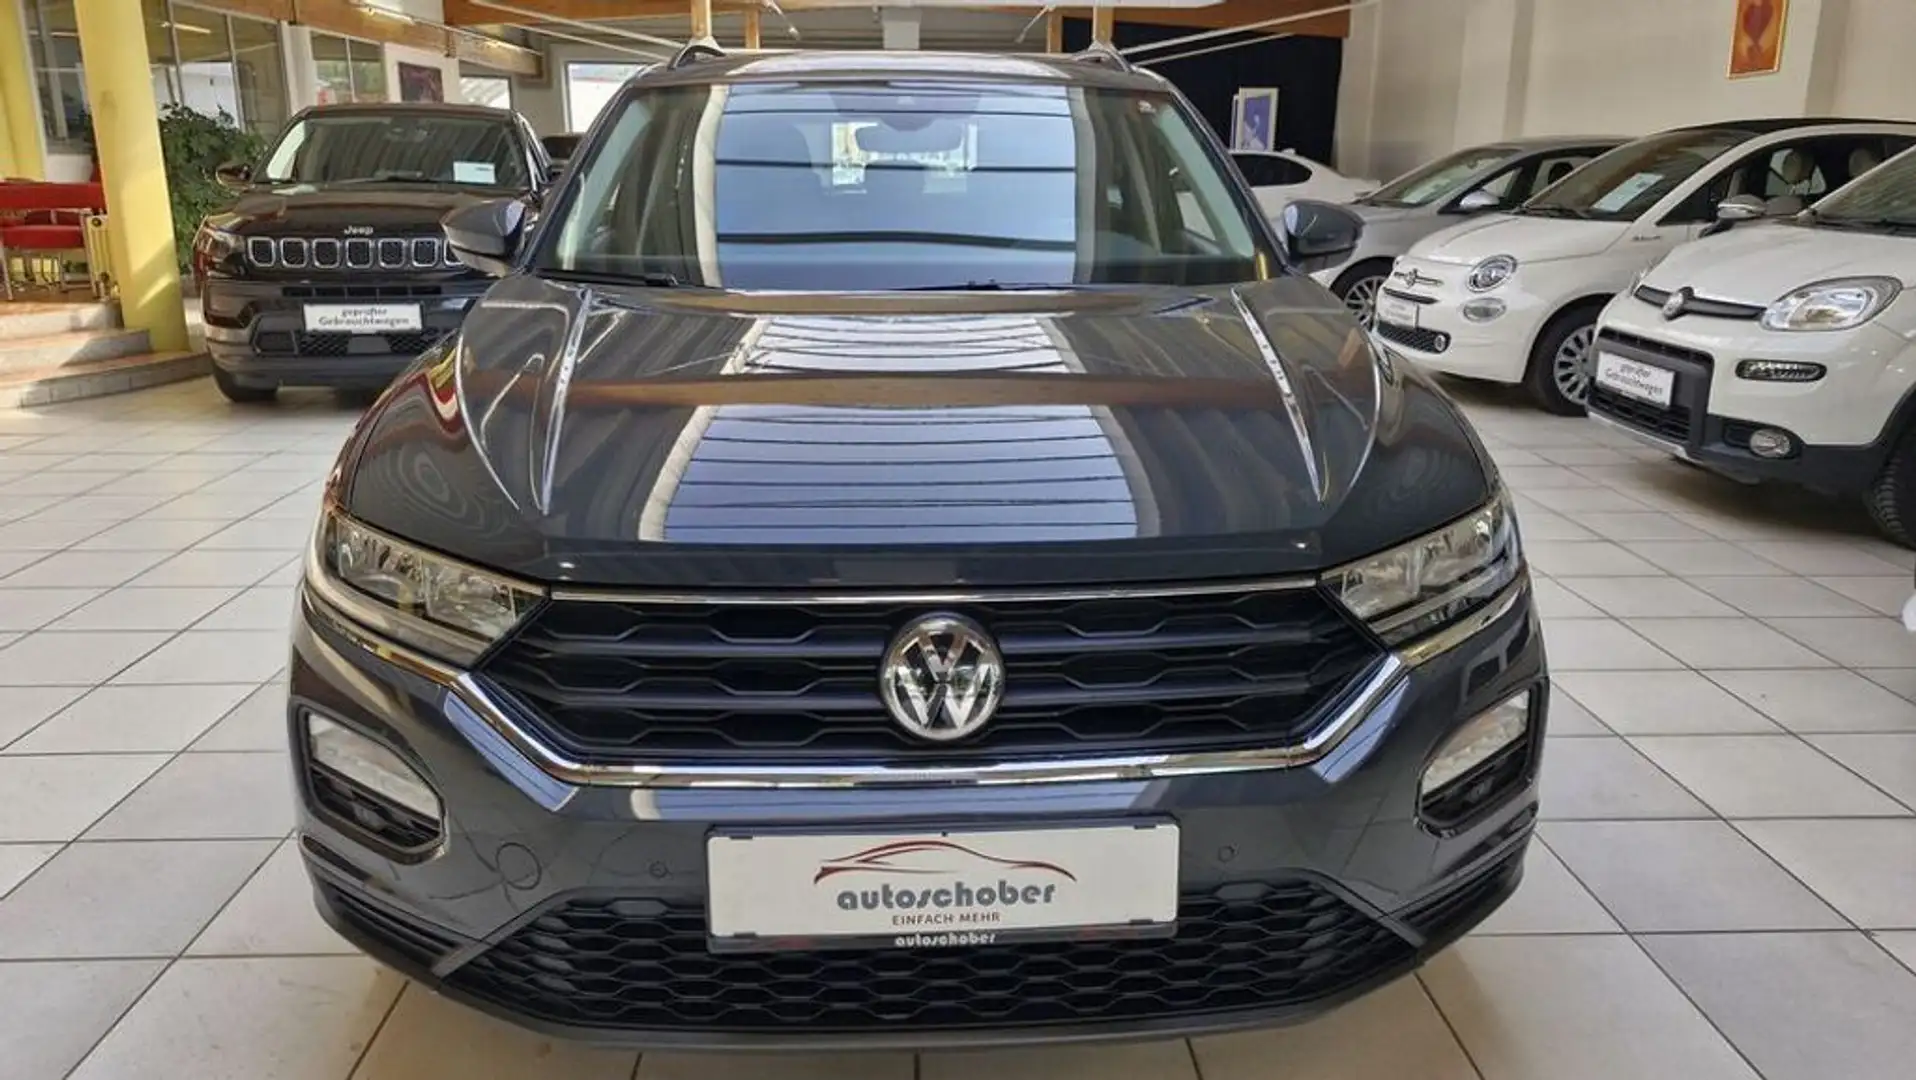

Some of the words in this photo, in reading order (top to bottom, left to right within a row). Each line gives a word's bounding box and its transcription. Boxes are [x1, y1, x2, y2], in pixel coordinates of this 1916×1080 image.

[837, 880, 1055, 910] autoschober
[892, 913, 952, 926] EINFACH
[959, 911, 1001, 923] MEHR
[894, 932, 997, 947] autoschober
